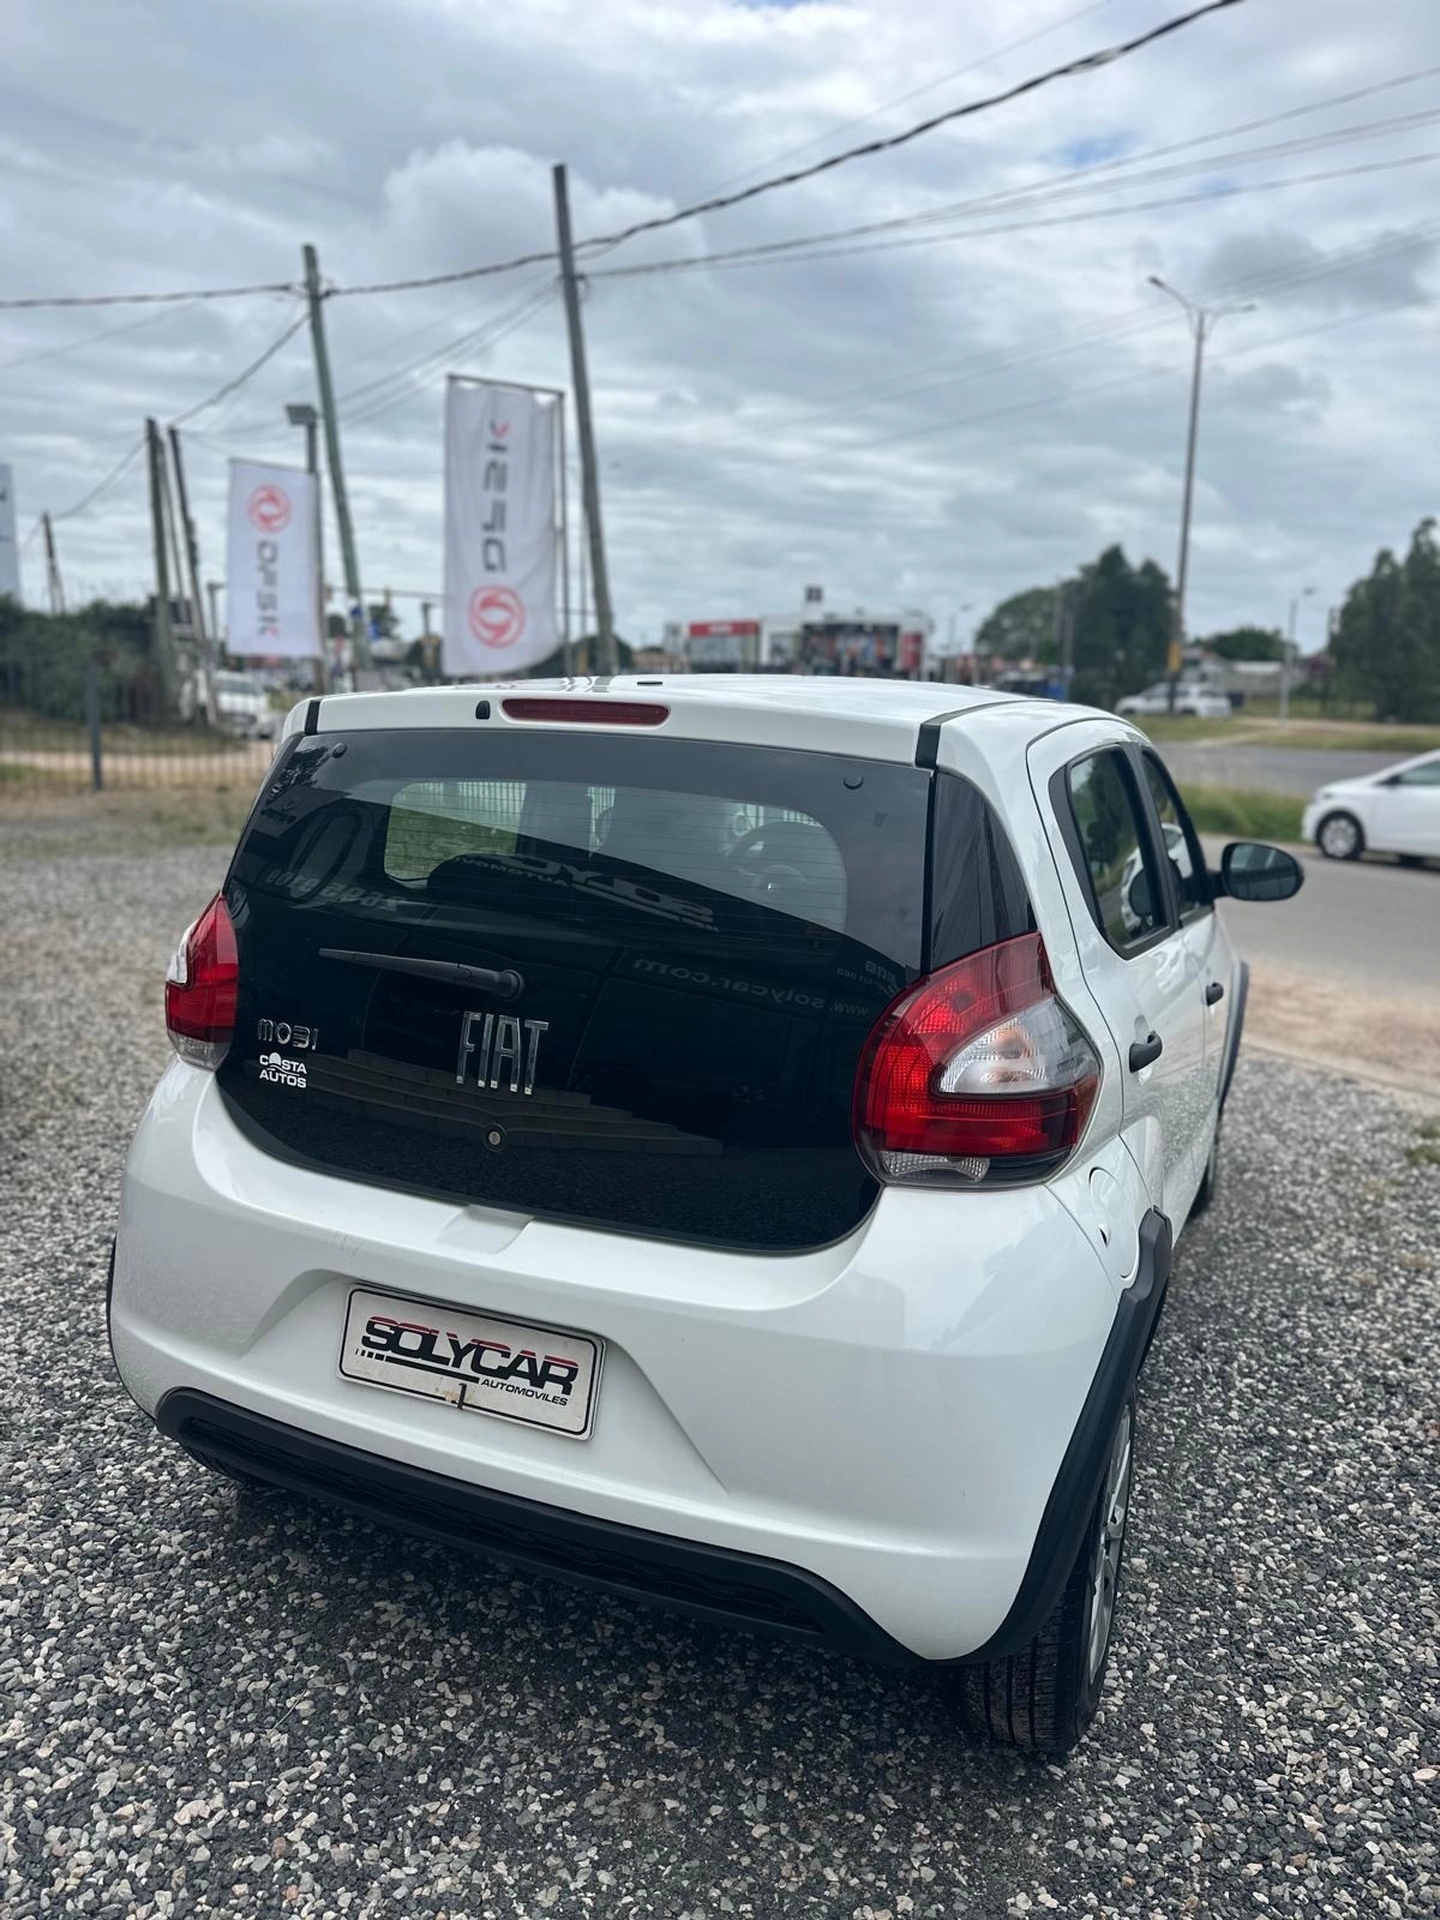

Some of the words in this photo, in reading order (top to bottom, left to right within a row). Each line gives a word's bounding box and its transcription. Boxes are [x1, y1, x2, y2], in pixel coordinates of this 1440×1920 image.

[256, 540, 282, 638] DFSK
[256, 1018, 319, 1051] MOBI
[456, 1010, 550, 1096] FIAT
[258, 1068, 307, 1089] AUTOS
[360, 1314, 580, 1396] SOLYCAR
[480, 1377, 569, 1407] AUTOMOVILES
